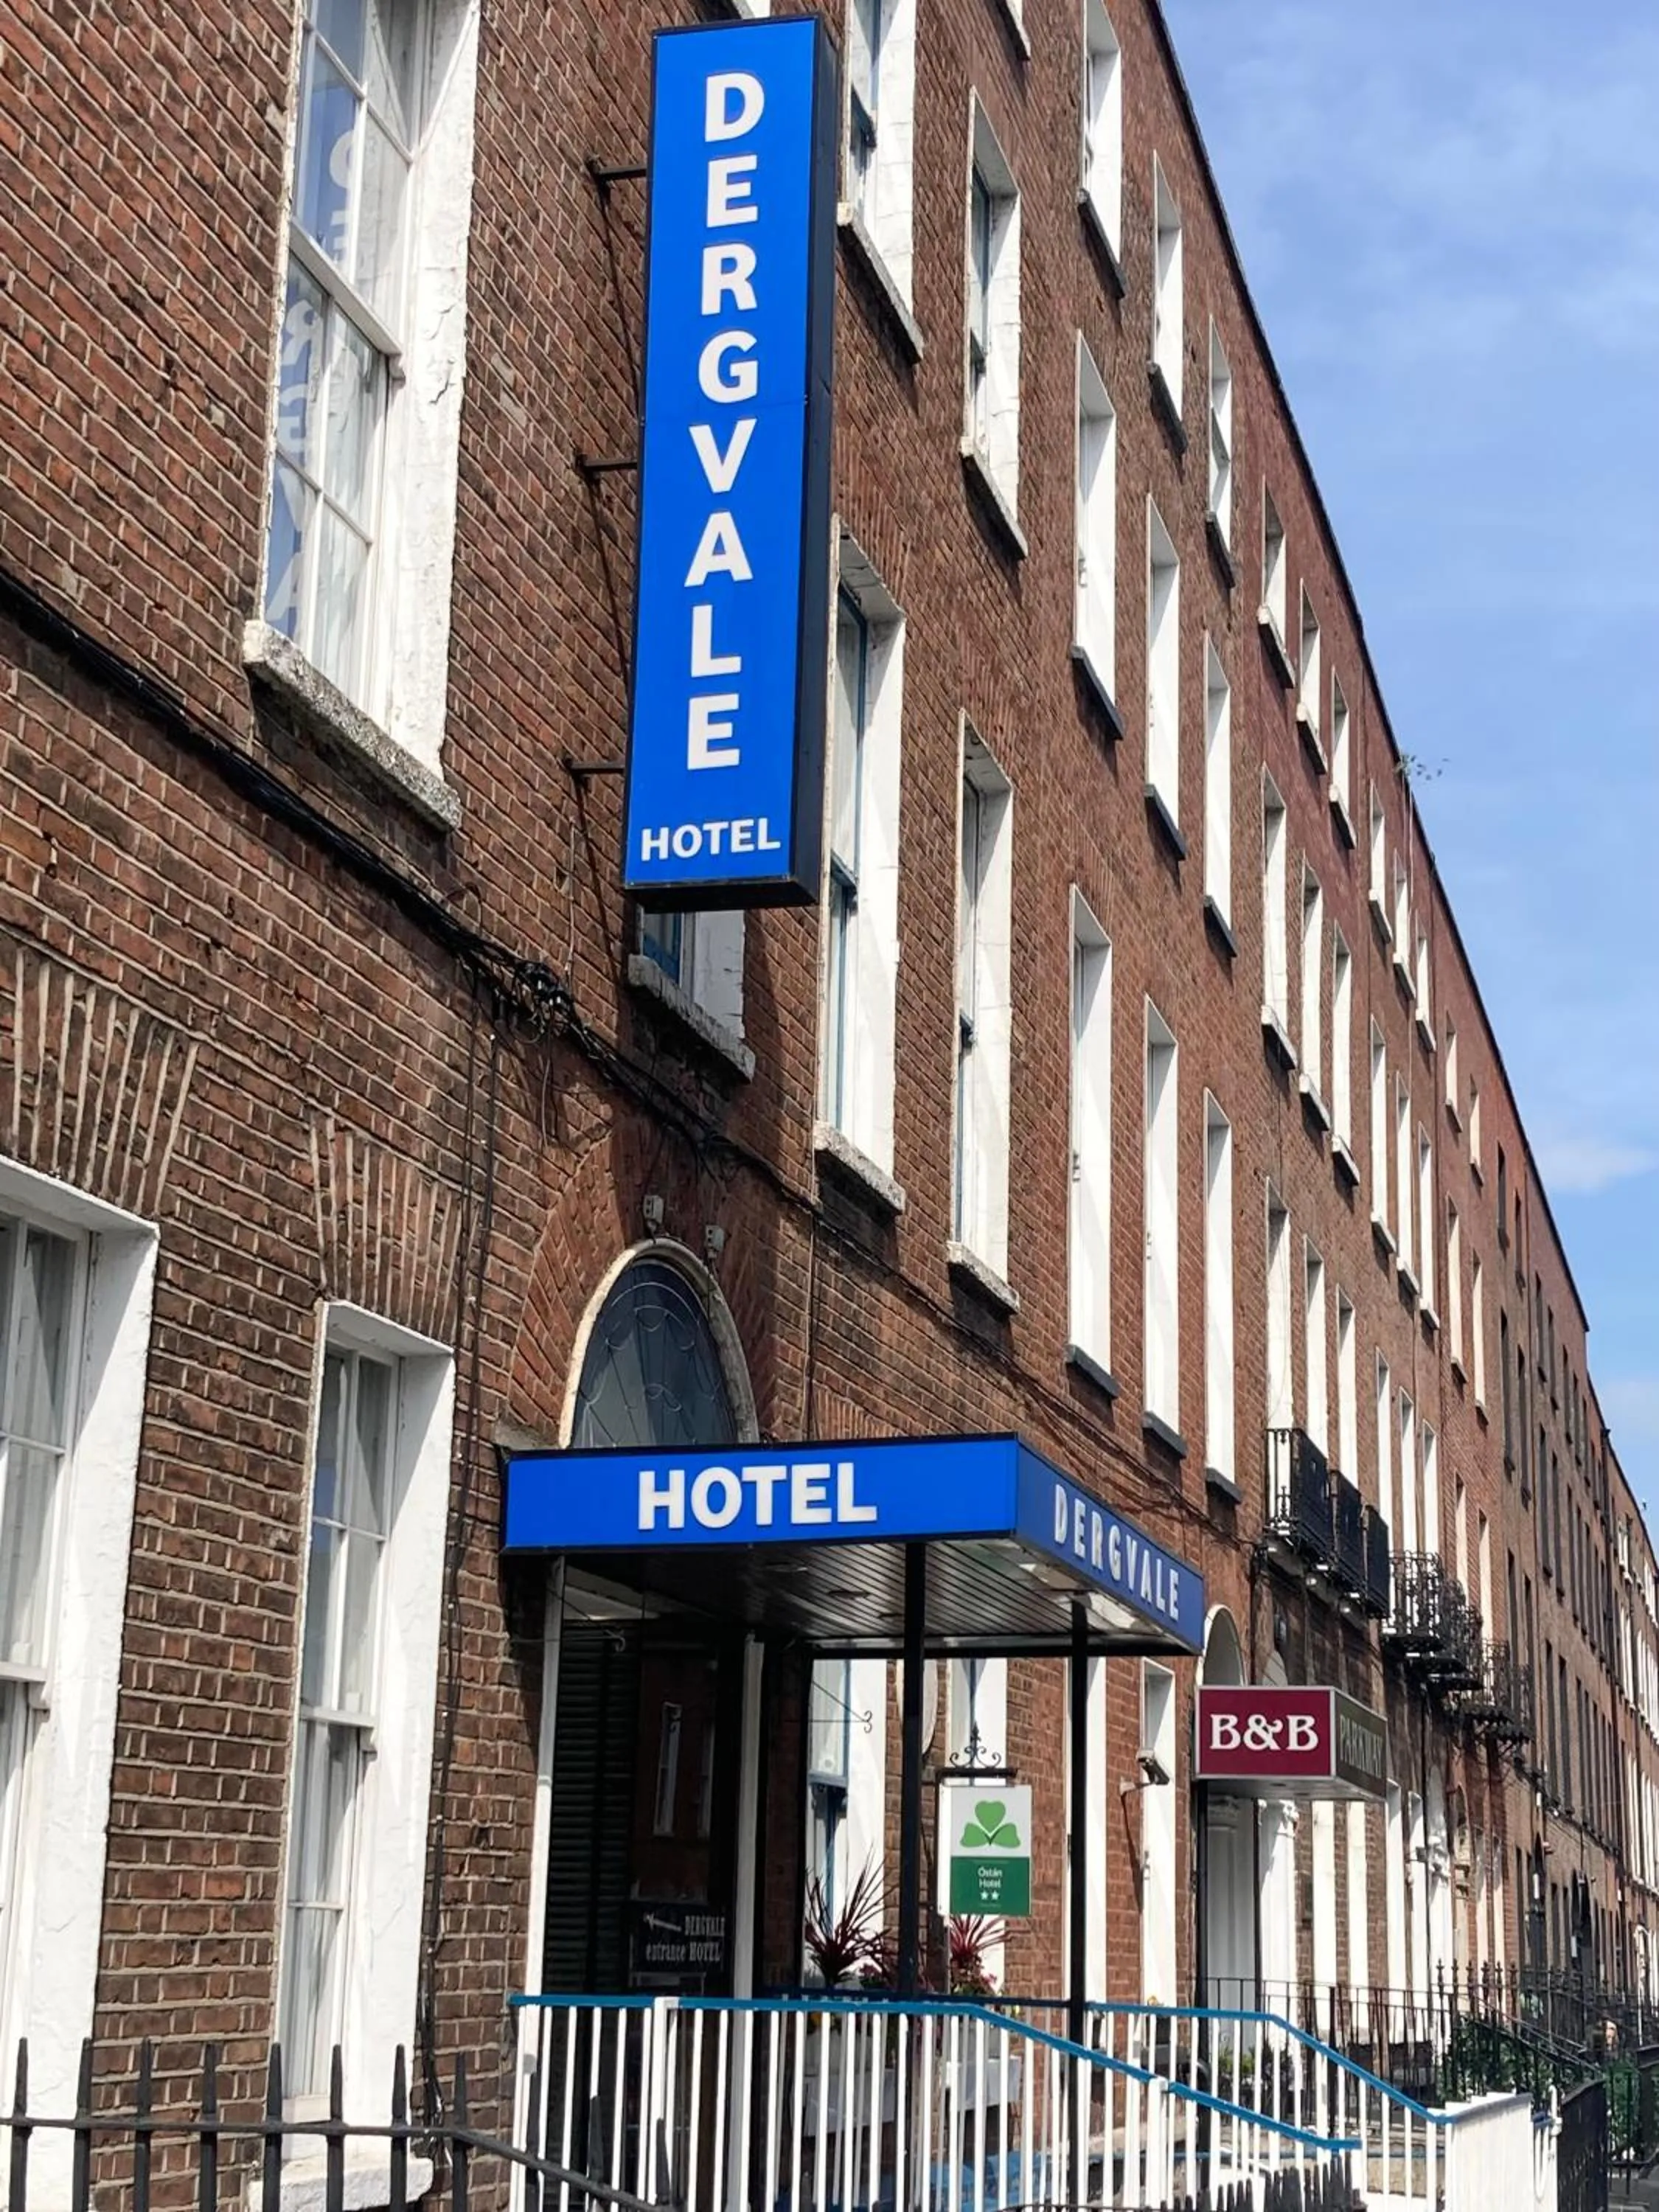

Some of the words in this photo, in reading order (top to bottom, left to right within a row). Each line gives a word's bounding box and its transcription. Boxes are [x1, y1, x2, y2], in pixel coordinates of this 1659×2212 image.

[684, 72, 765, 771] DERGVALE
[641, 817, 781, 861] HOTEL
[639, 1461, 877, 1531] HOTEL
[1054, 1484, 1179, 1622] DERGVALE
[1209, 1714, 1319, 1750] B&B
[978, 1878, 1001, 1888] Hotel
[646, 1942, 686, 1961] entrance
[689, 1941, 720, 1961] HOTEL
